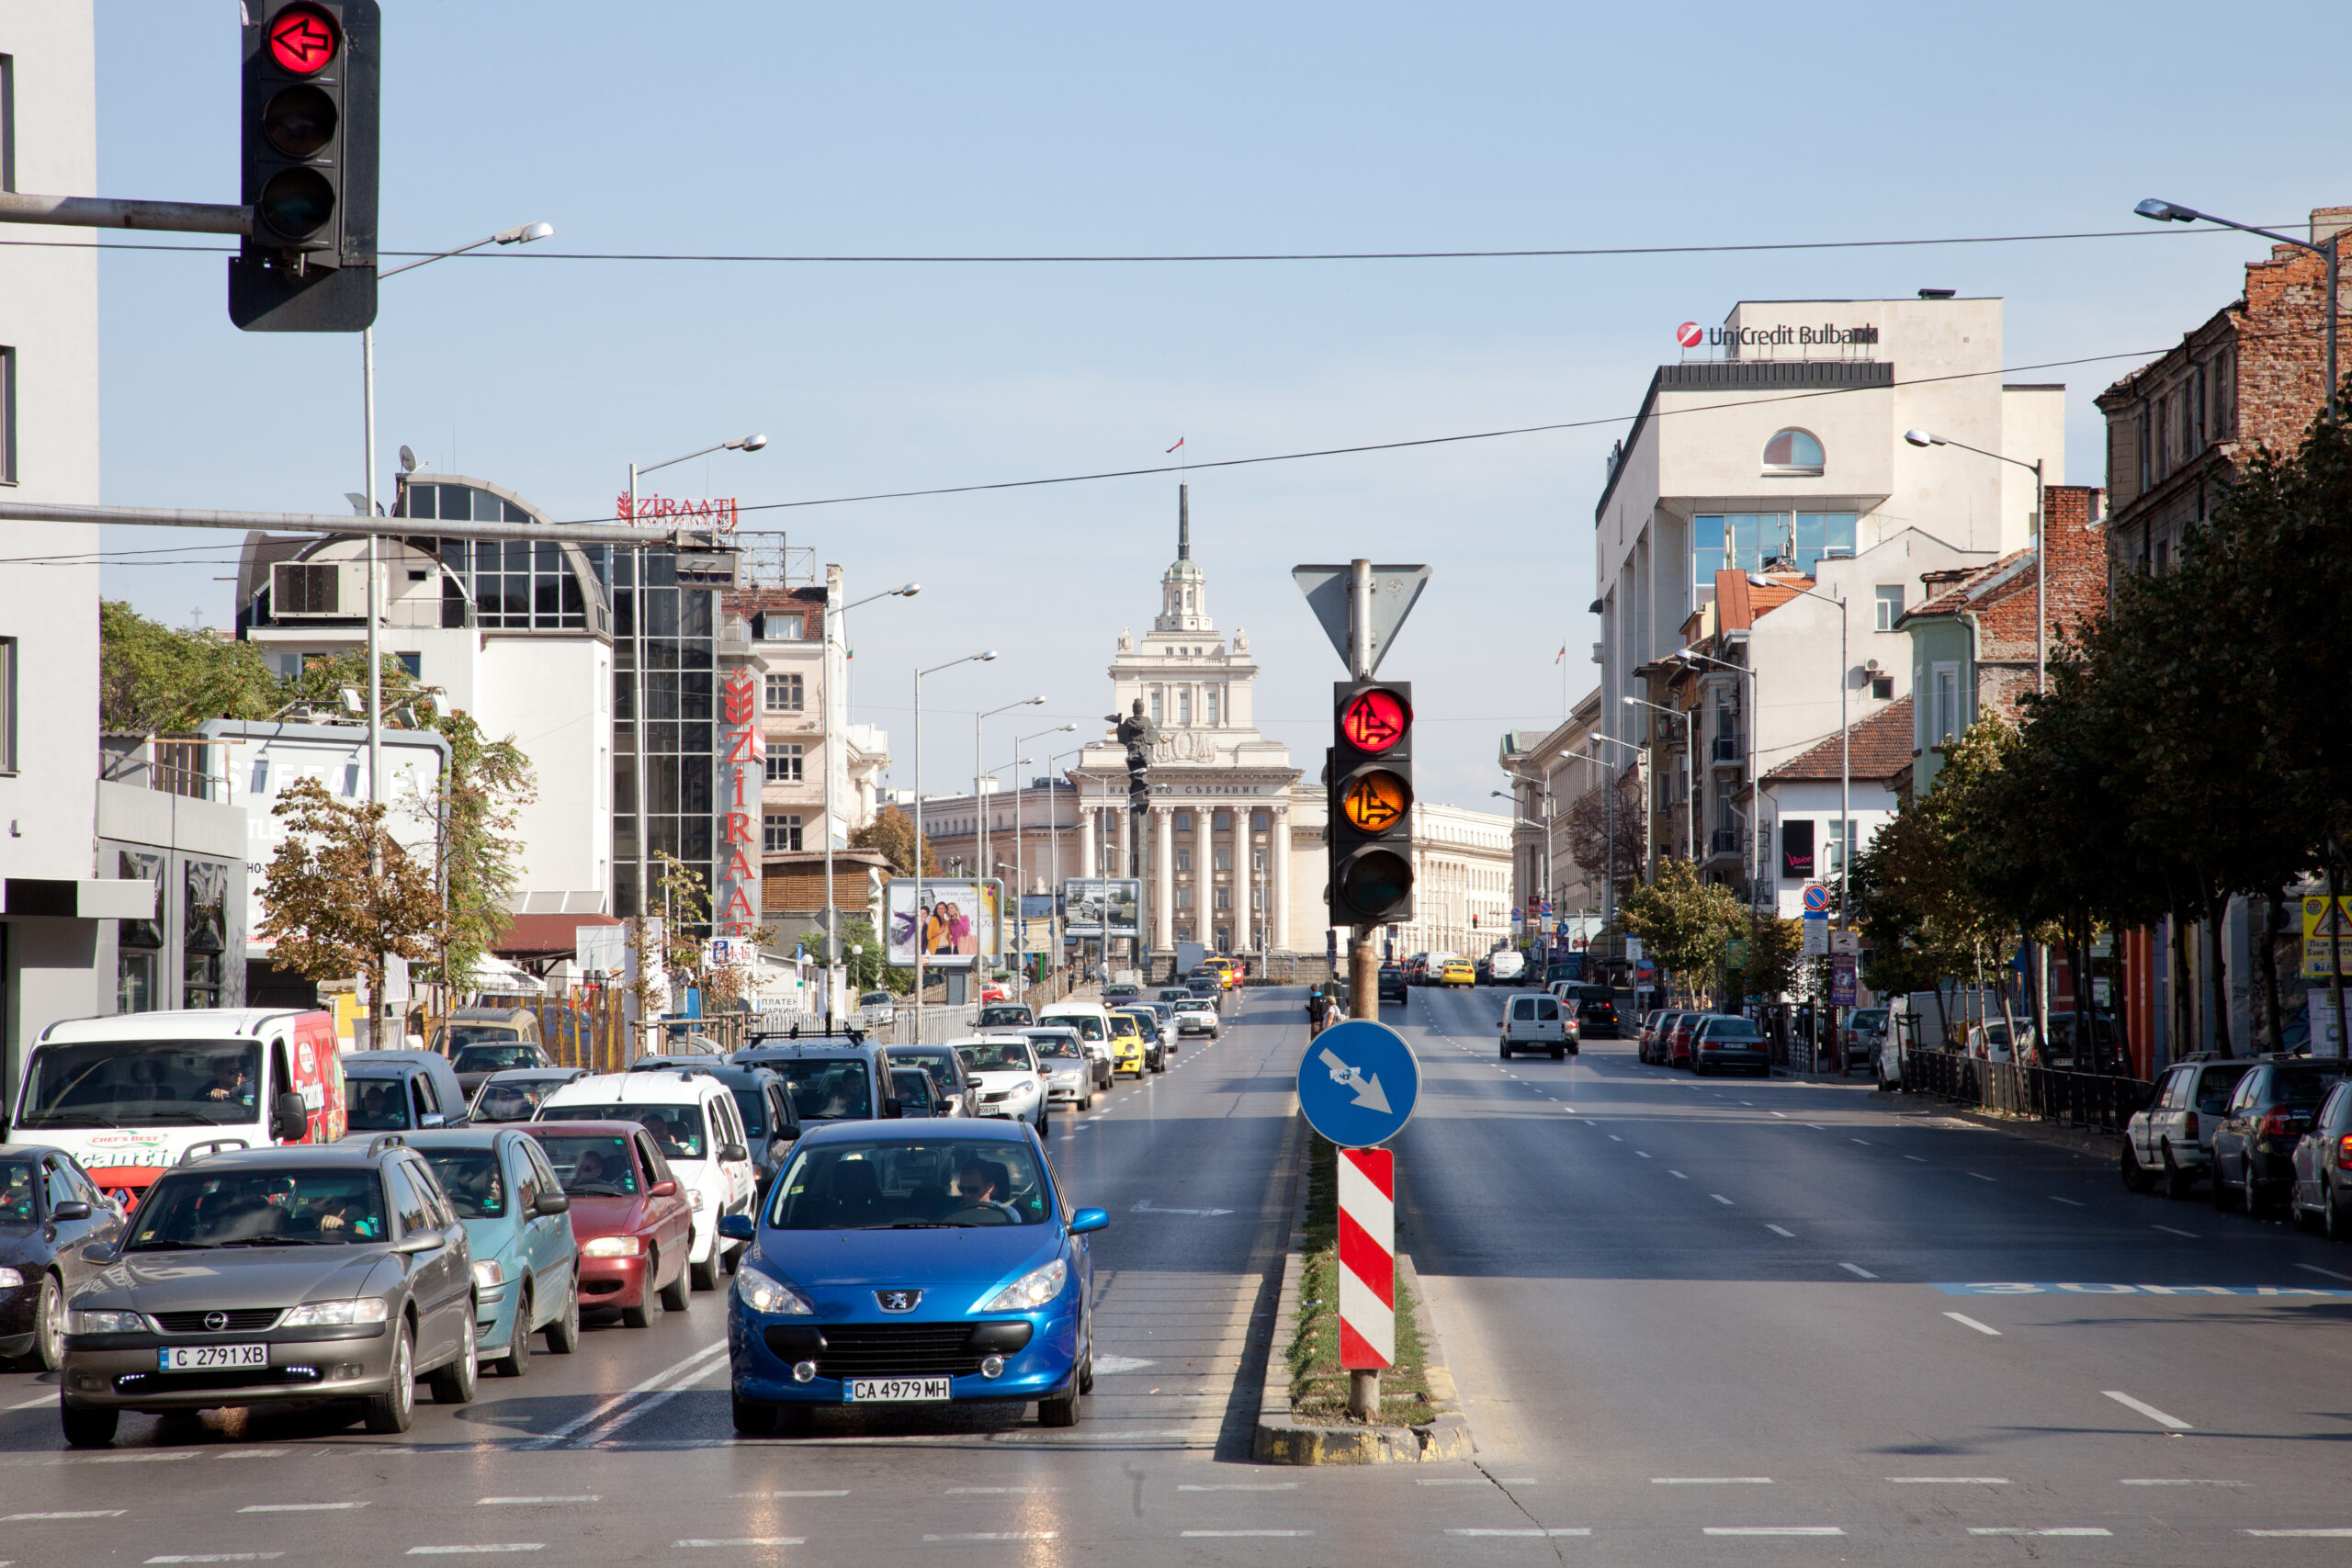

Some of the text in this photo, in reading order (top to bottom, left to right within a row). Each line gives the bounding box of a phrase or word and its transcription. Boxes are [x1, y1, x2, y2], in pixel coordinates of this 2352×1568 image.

[1709, 322, 1879, 345] UniCredit Bulbank
[1185, 786, 1261, 795] СЪБРАНИЕ
[2306, 948, 2325, 956] Save
[176, 1347, 264, 1366] C 2791 XB
[854, 1381, 948, 1399] CA 4979 MH
